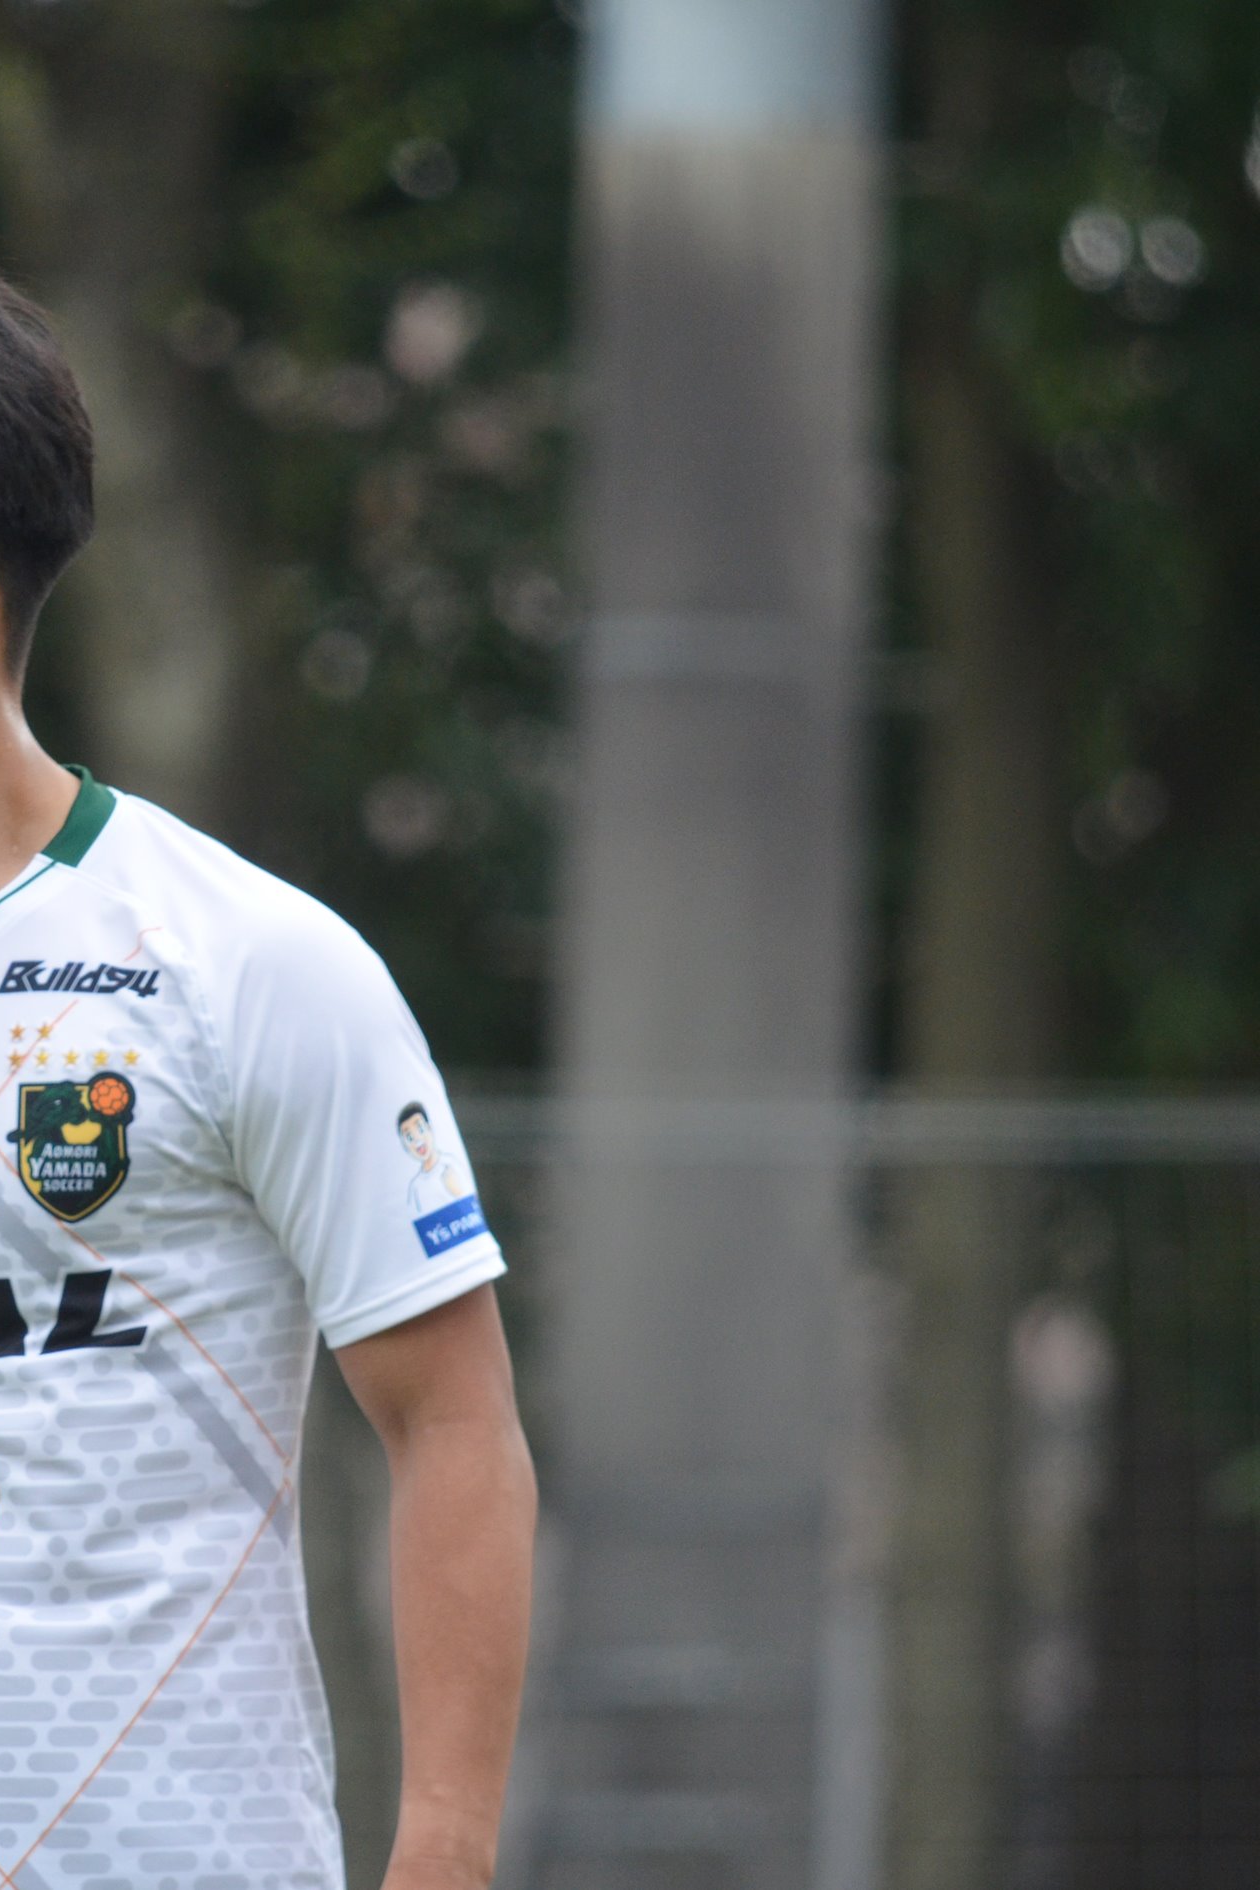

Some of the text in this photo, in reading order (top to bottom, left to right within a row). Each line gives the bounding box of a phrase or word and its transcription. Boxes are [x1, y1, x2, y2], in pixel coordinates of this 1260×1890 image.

[40, 1142, 99, 1159] AOMORI
[29, 1156, 107, 1179] YAMADA
[42, 1178, 94, 1192] SOCCER
